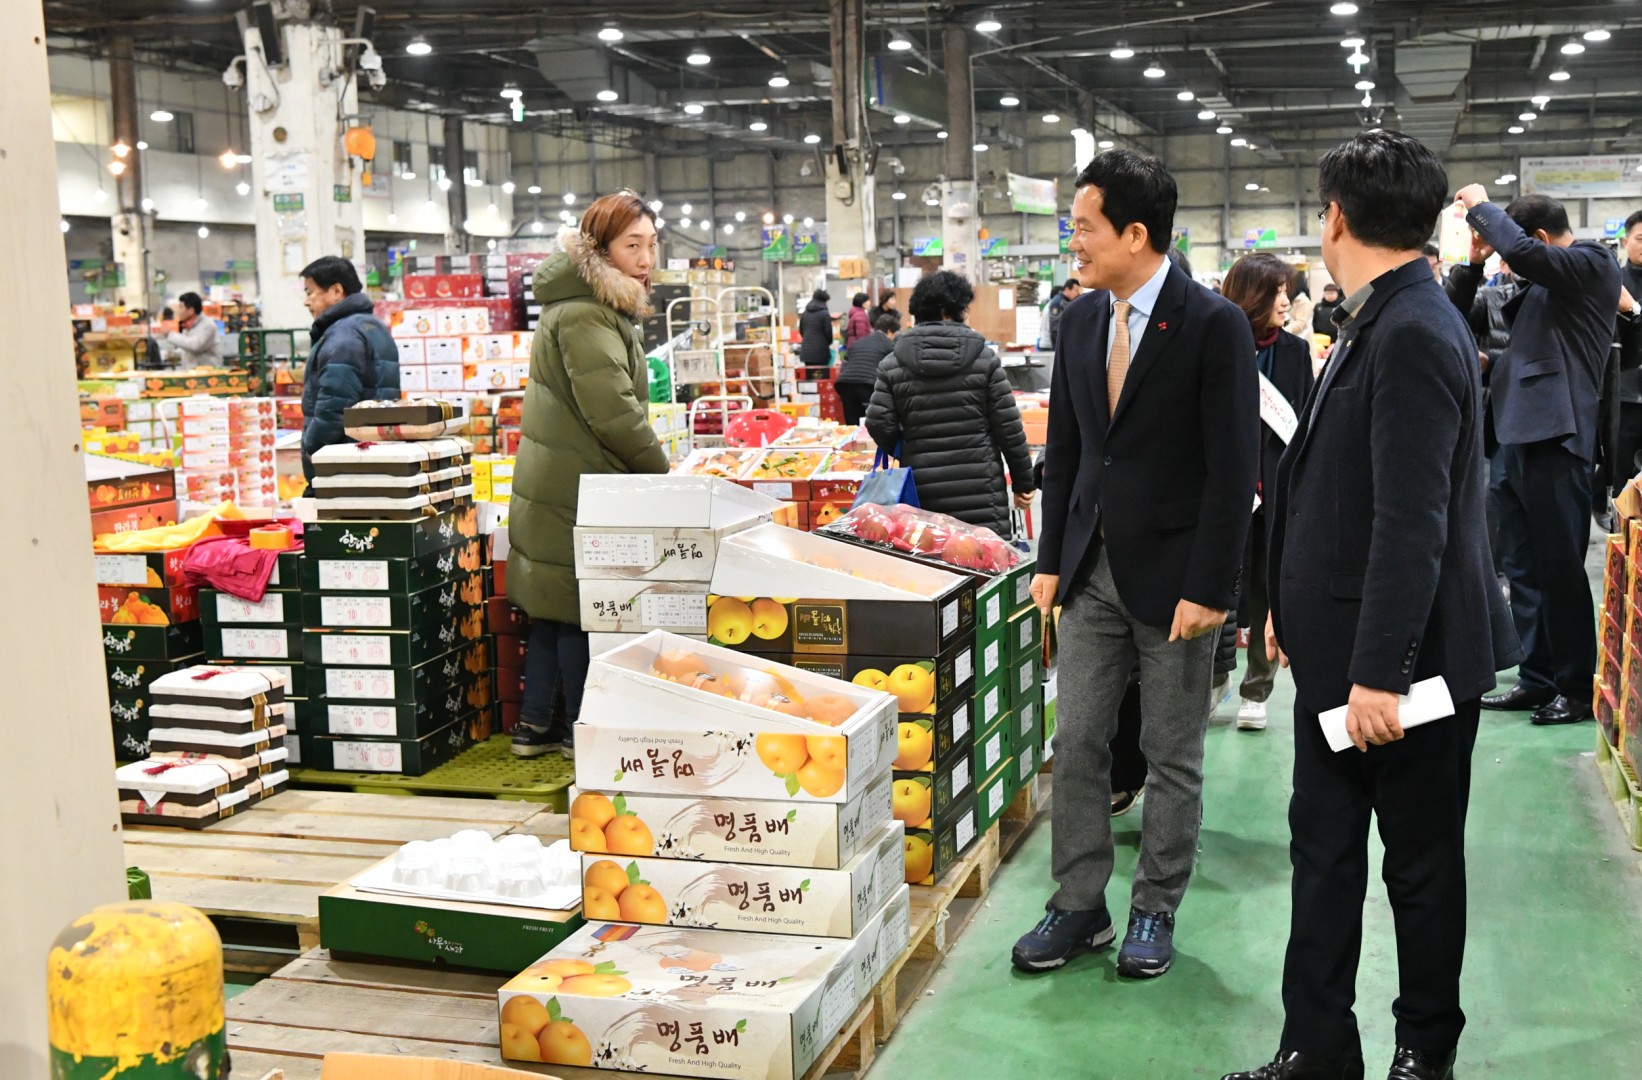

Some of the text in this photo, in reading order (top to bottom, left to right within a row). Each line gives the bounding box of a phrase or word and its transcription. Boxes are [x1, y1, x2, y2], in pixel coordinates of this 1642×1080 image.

[664, 543, 703, 560] 명품배
[593, 601, 632, 616] 명품배
[640, 736, 653, 745] High
[666, 737, 684, 745] Fresh
[621, 748, 694, 778] 명품배
[714, 812, 789, 843] 명품배
[724, 845, 791, 856] Fresh And High Quality
[728, 881, 803, 912] 명품배
[737, 914, 805, 925] Fresh And High Quality
[680, 974, 778, 991] 명품배
[656, 1020, 739, 1055] 명품배
[669, 1056, 741, 1070] Fresh And High Quality
